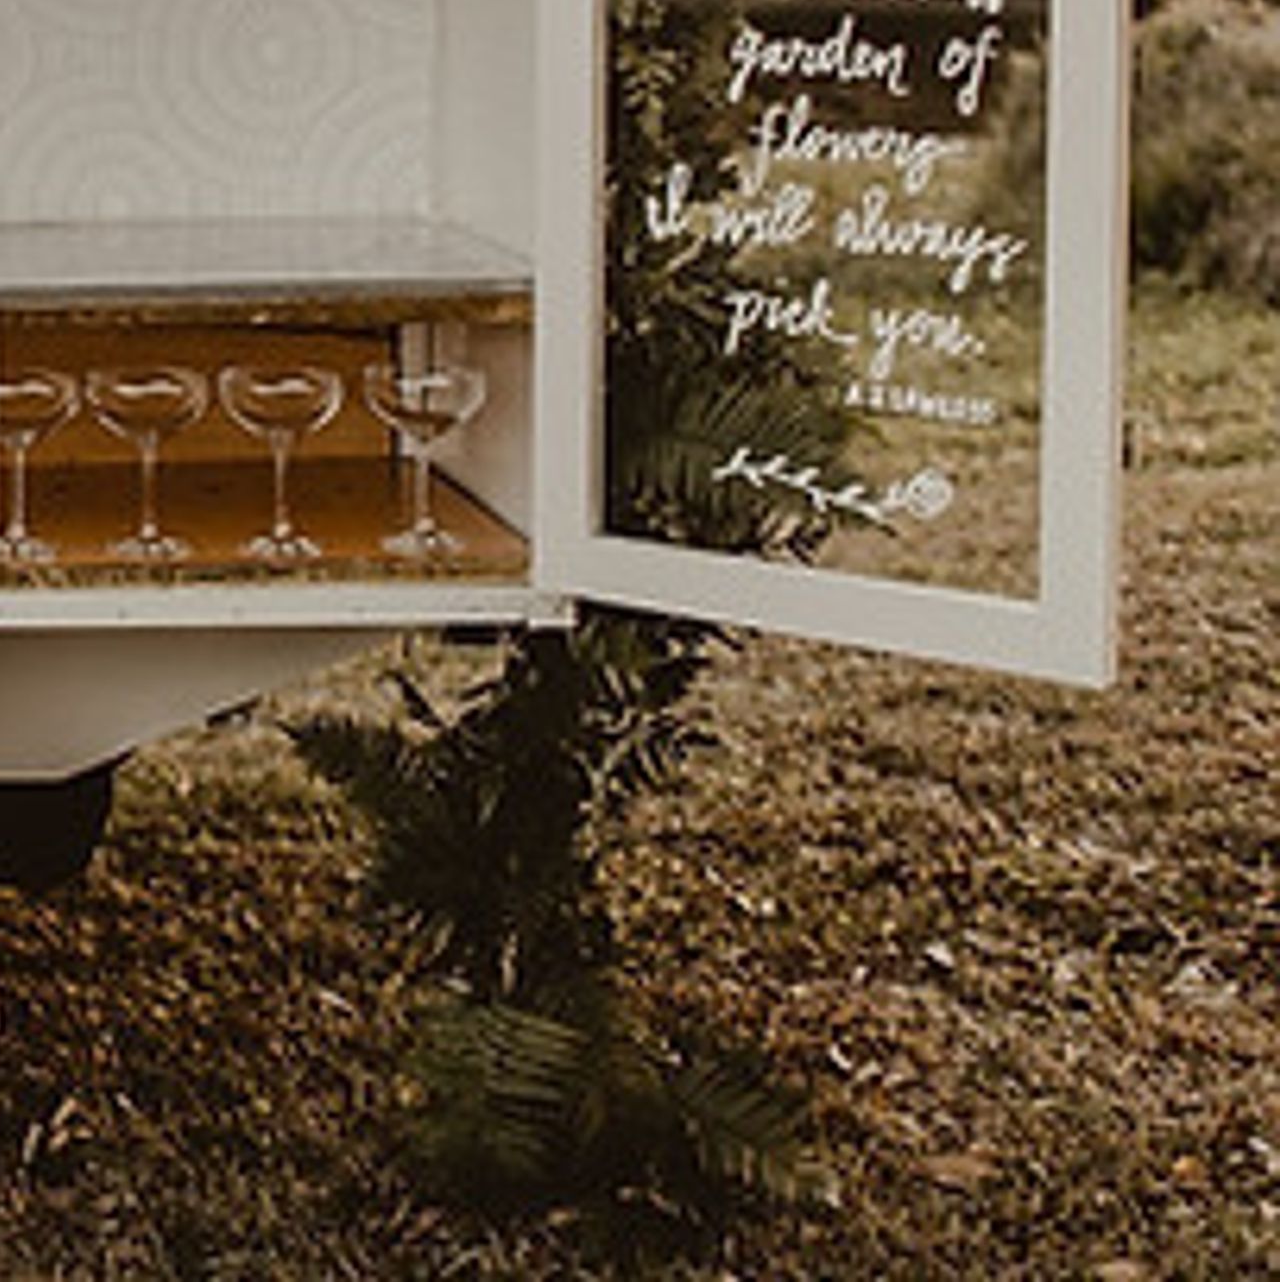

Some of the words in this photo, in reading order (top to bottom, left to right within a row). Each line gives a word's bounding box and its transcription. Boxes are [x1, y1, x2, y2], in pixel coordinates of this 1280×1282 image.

[729, 14, 909, 103] garden
[939, 26, 1002, 116] of
[712, 182, 816, 247] will
[836, 184, 1028, 293] always
[724, 276, 858, 356] pick
